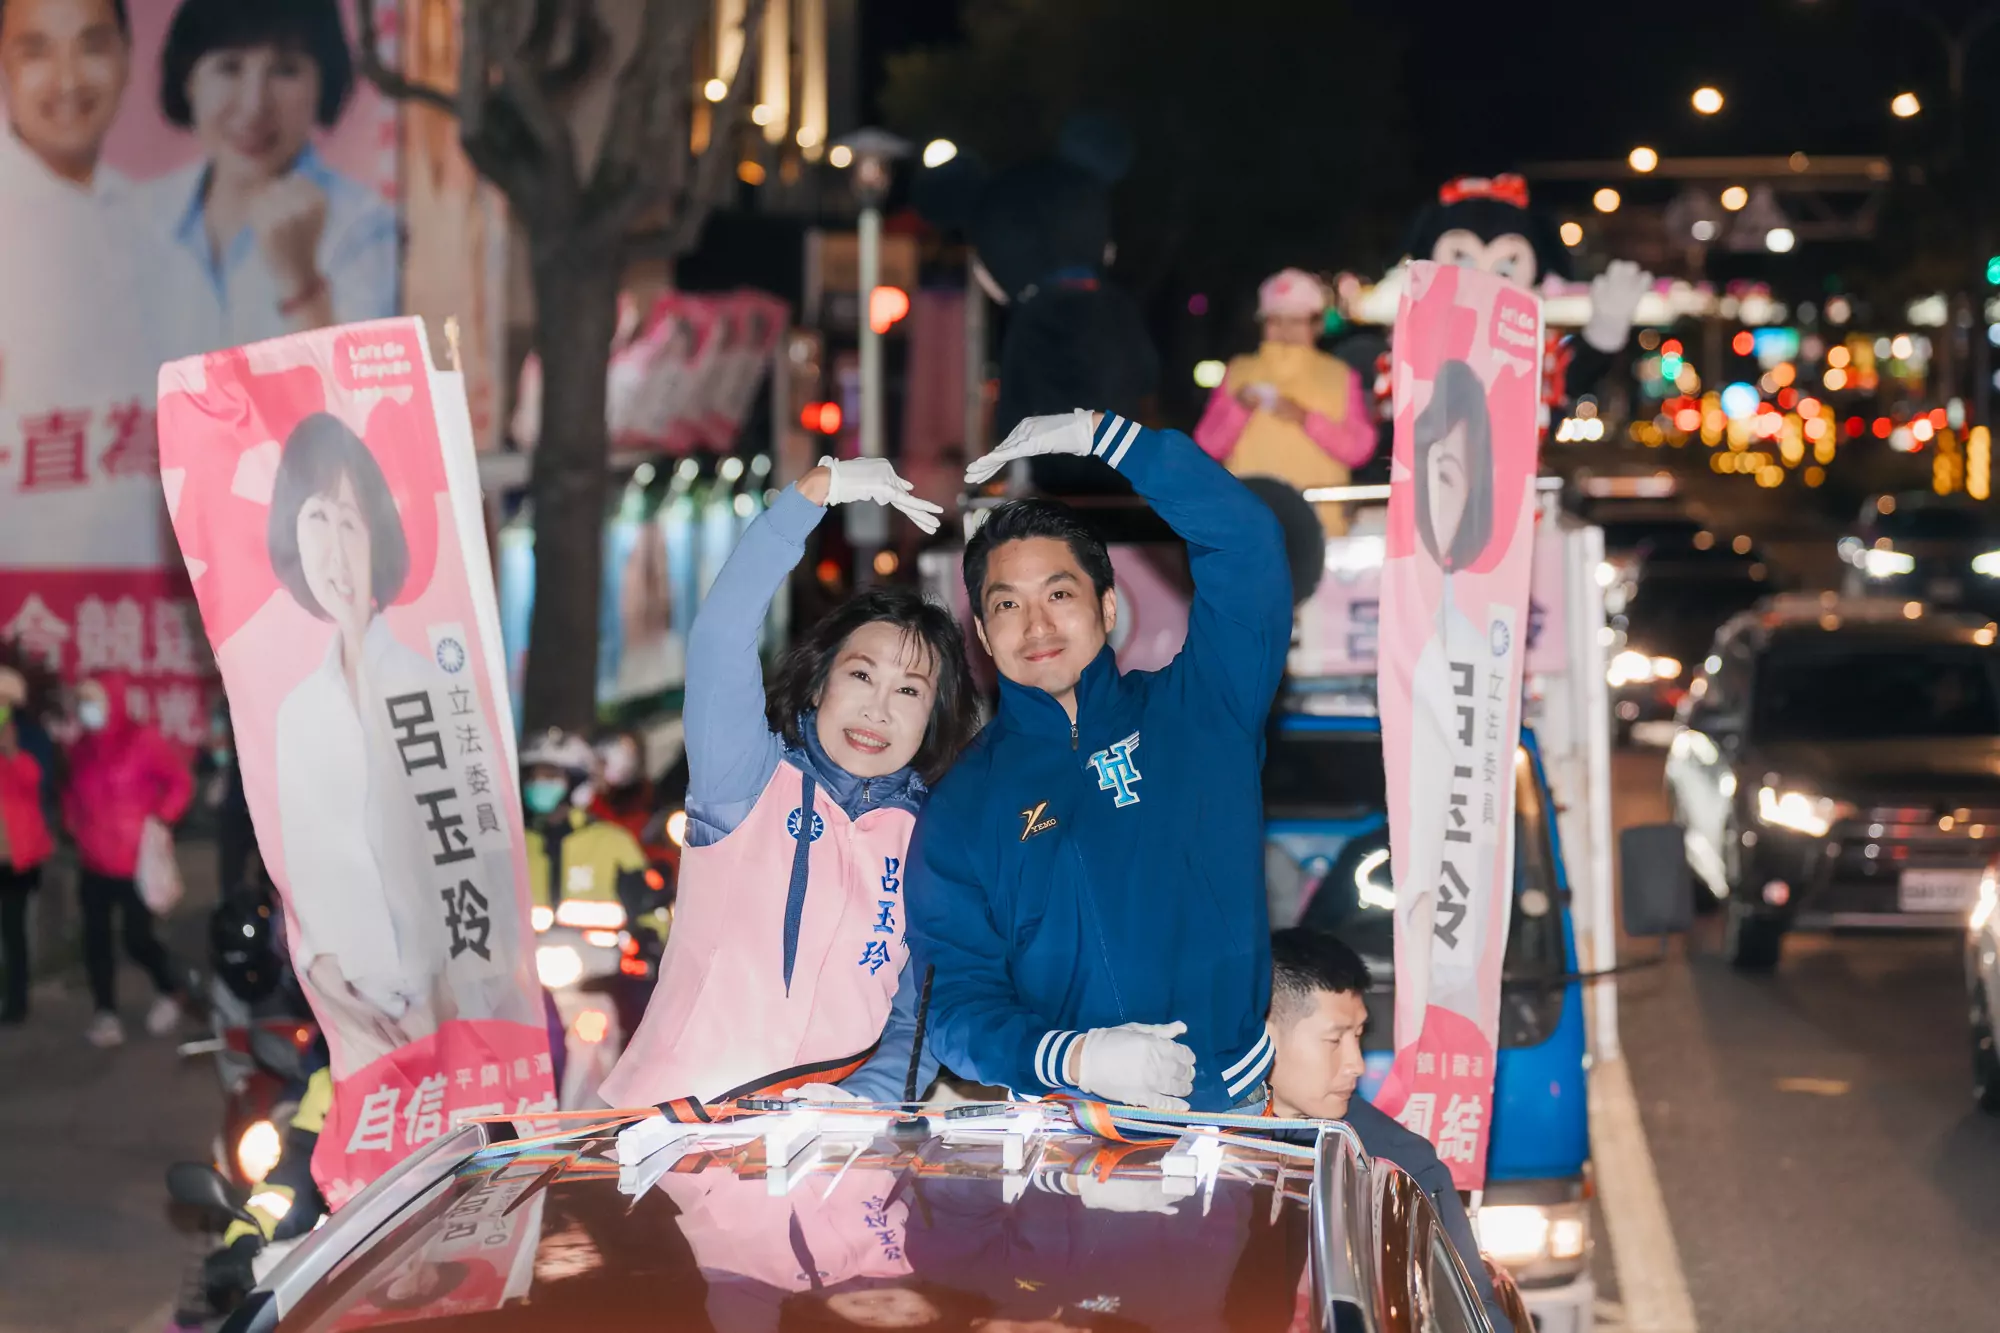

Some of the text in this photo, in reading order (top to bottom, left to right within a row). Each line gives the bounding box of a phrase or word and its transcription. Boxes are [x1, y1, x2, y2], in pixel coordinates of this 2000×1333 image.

[385, 690, 492, 961] 呂玉玲
[447, 684, 501, 835] 立法委員
[1031, 818, 1057, 833] YEMO
[858, 856, 900, 976] 呂玉玲
